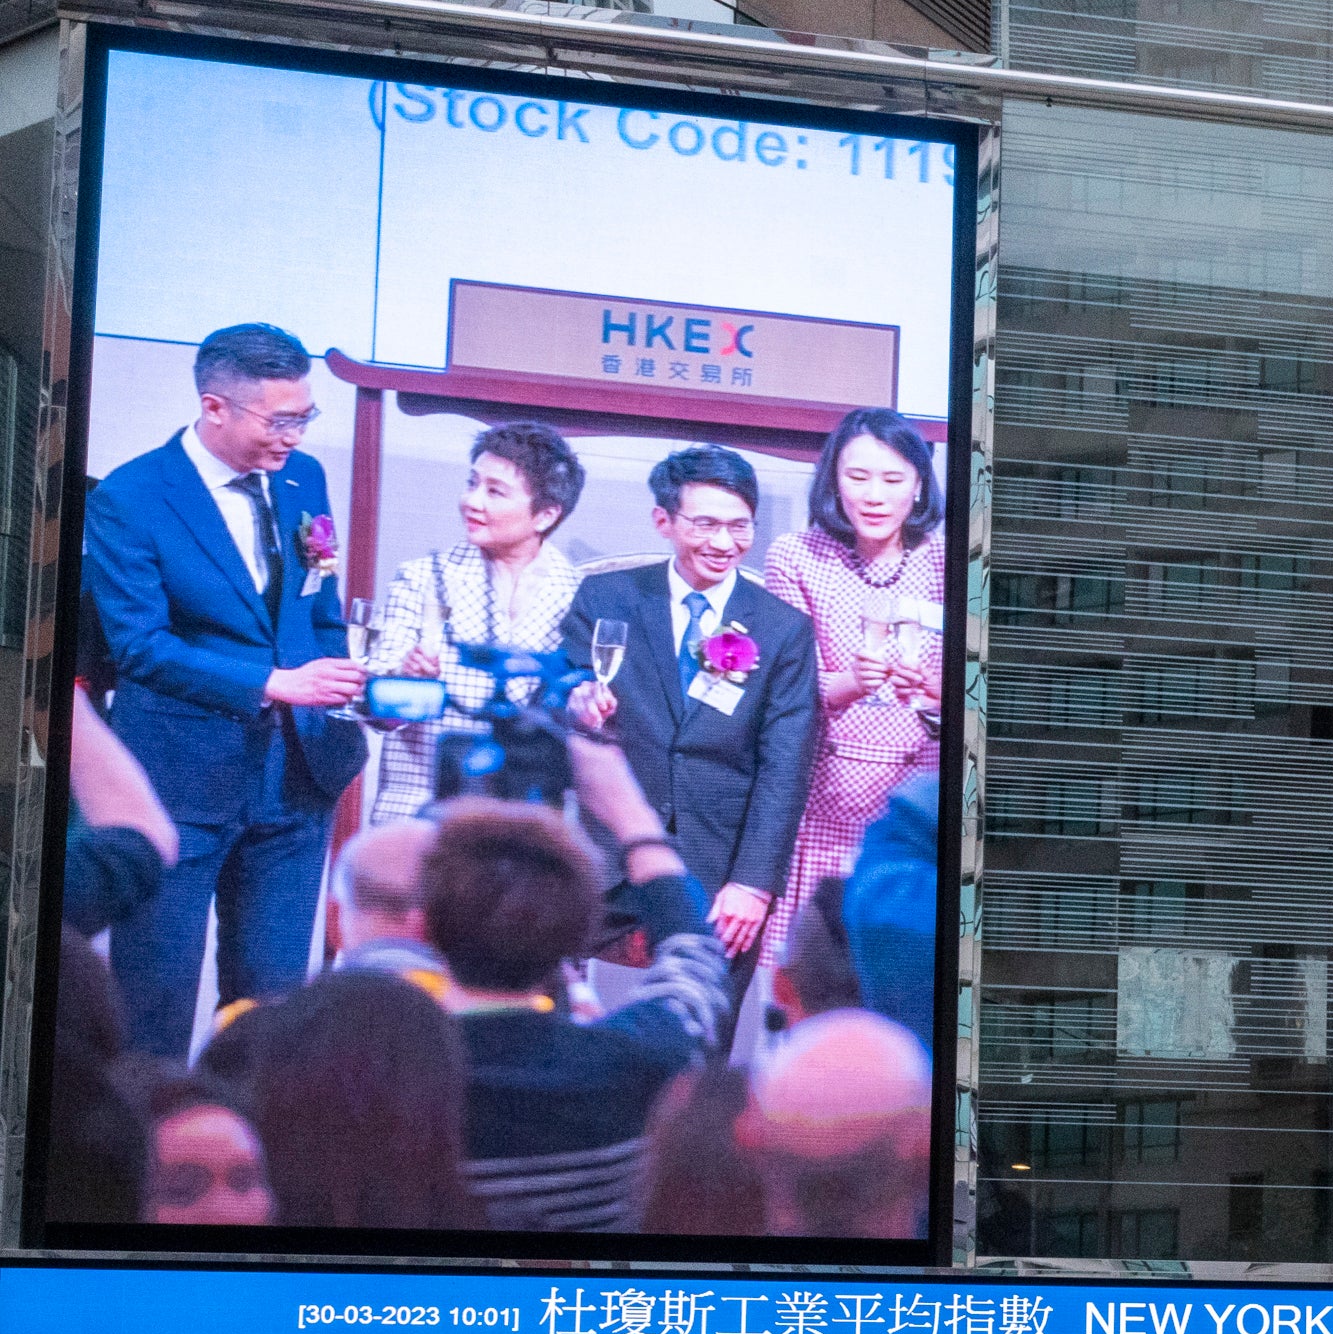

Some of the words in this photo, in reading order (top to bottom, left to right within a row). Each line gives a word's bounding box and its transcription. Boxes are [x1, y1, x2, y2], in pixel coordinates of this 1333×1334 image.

[616, 106, 808, 169] Code:
[602, 309, 754, 358] HKEX
[602, 354, 752, 387] 香港交易所
[298, 1305, 440, 1328] [30-03-2023
[450, 1307, 519, 1331] 10:01]
